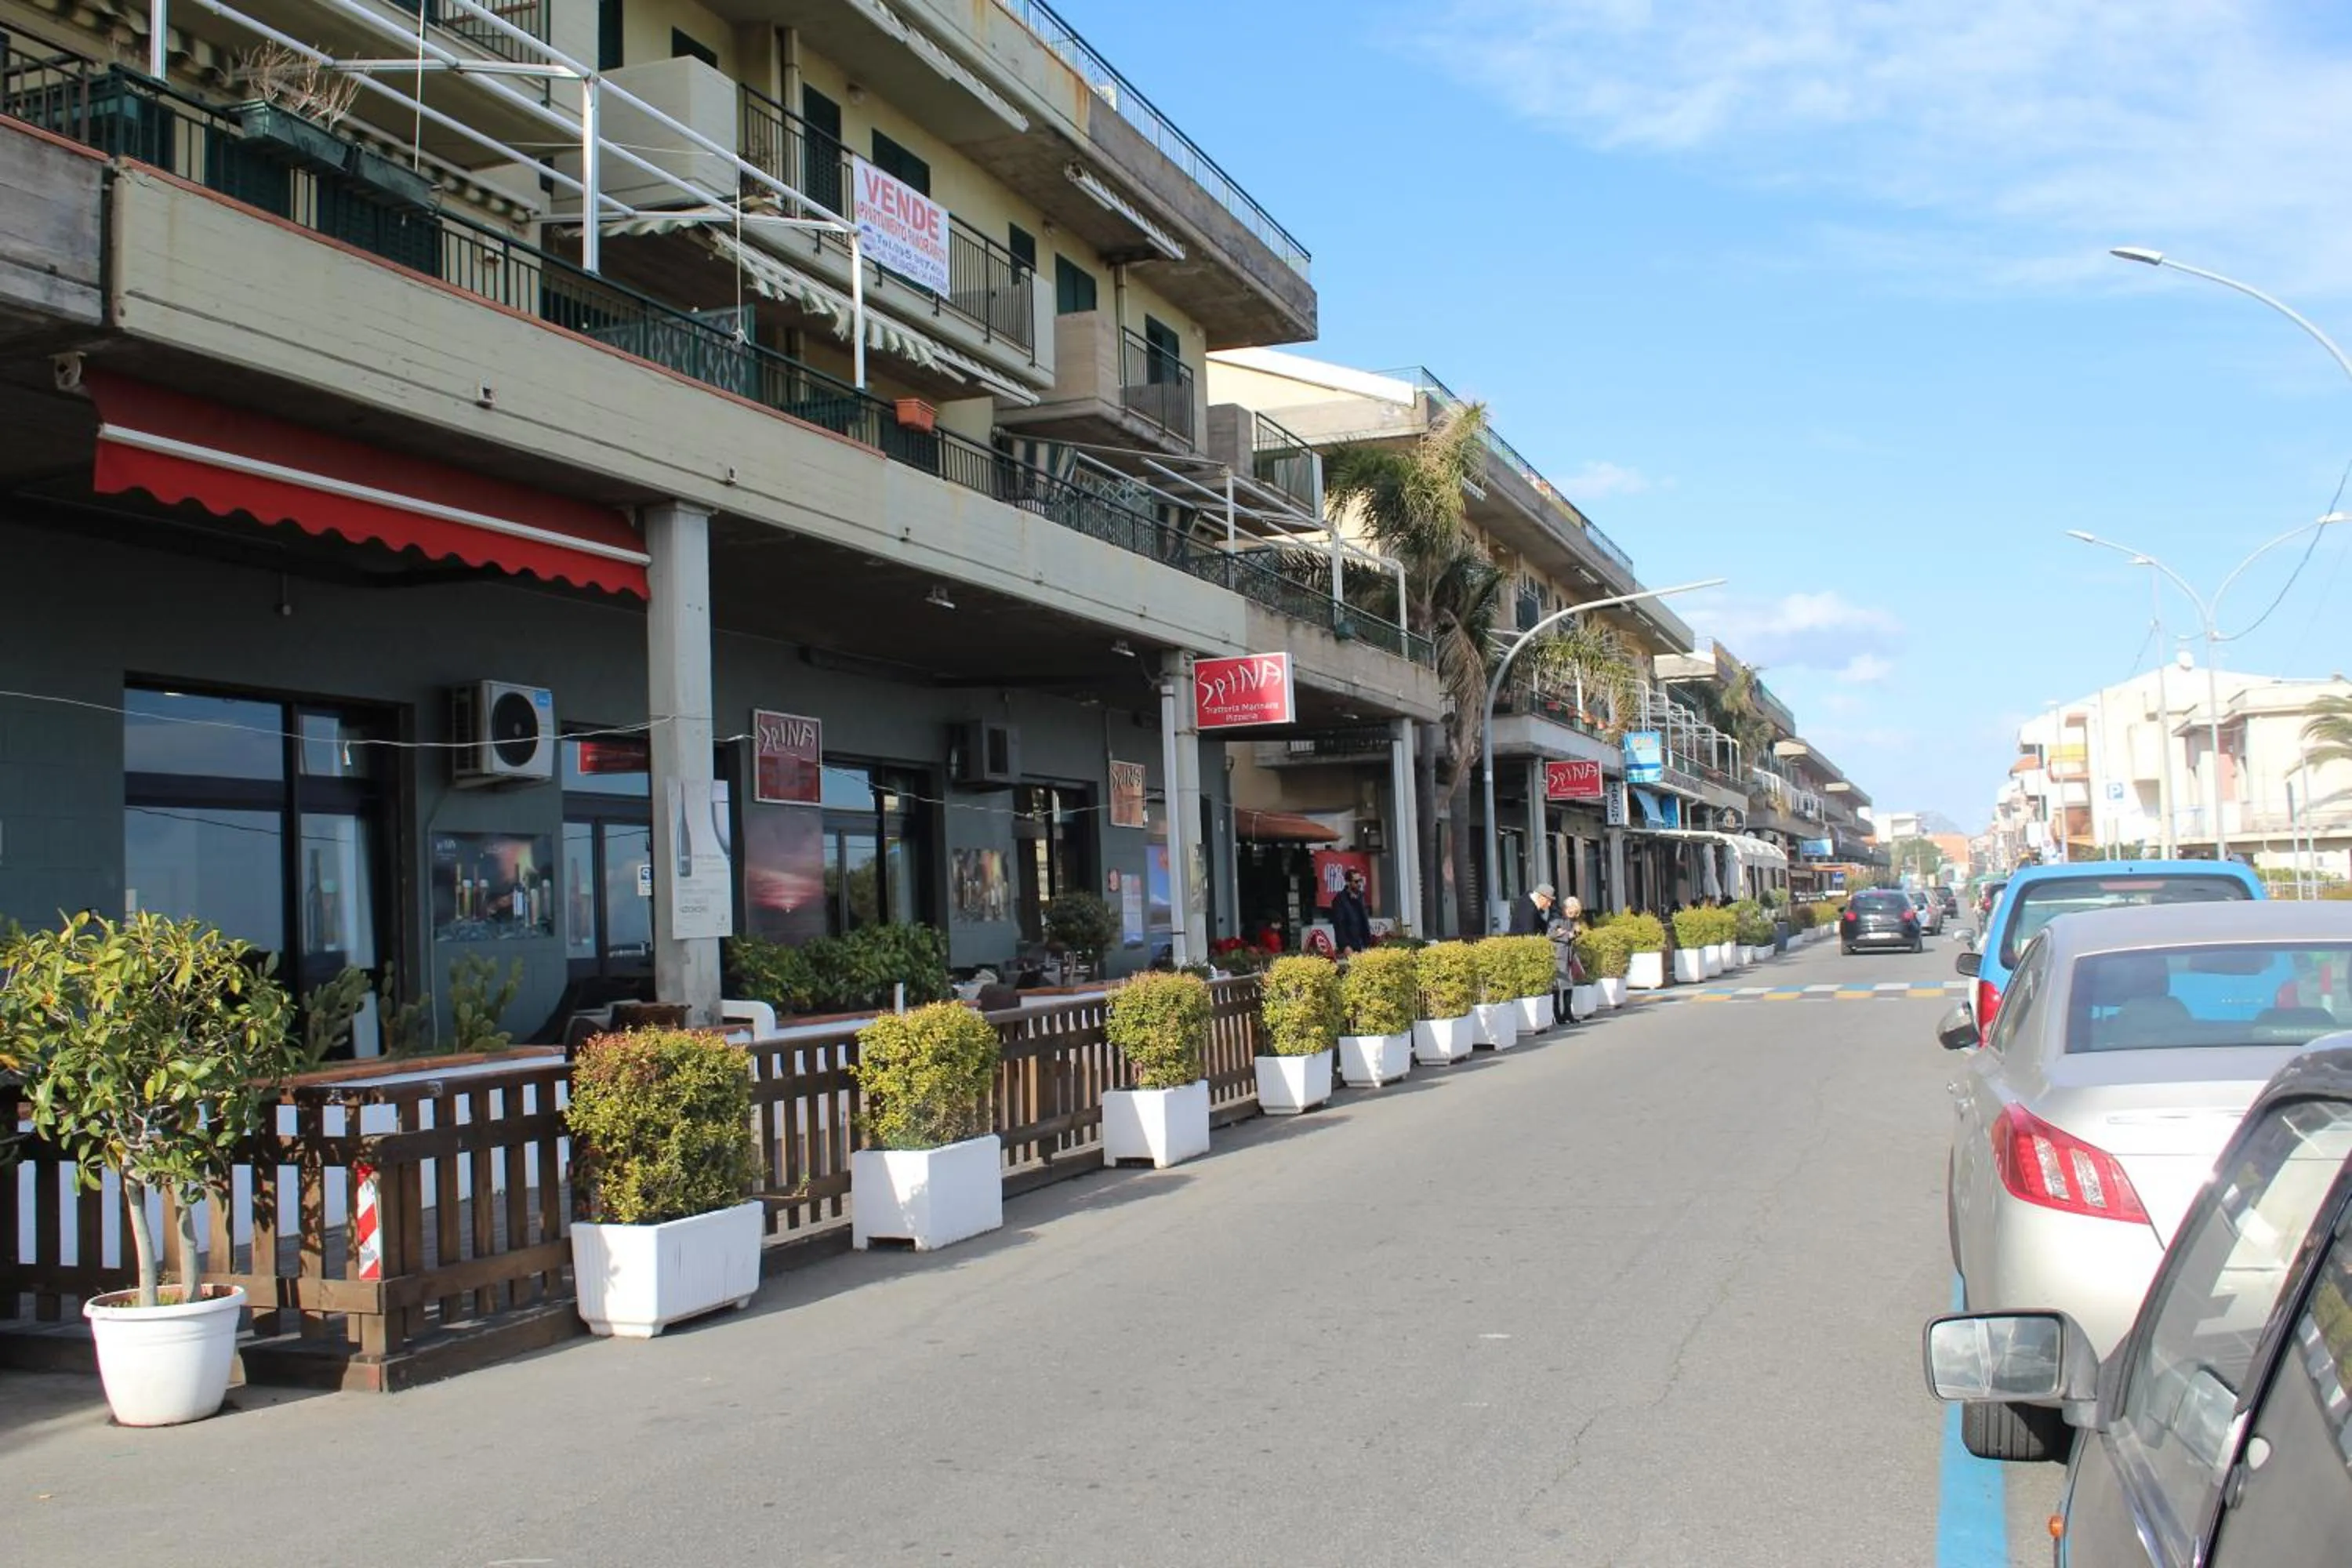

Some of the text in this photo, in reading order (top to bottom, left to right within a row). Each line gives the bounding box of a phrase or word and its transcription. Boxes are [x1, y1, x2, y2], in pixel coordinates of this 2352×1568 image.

[863, 168, 940, 241] VENDE
[1197, 658, 1282, 707] SPINA
[1204, 704, 1240, 715] Trattoria
[759, 720, 815, 753] SPINA
[1549, 763, 1597, 789] SPINA
